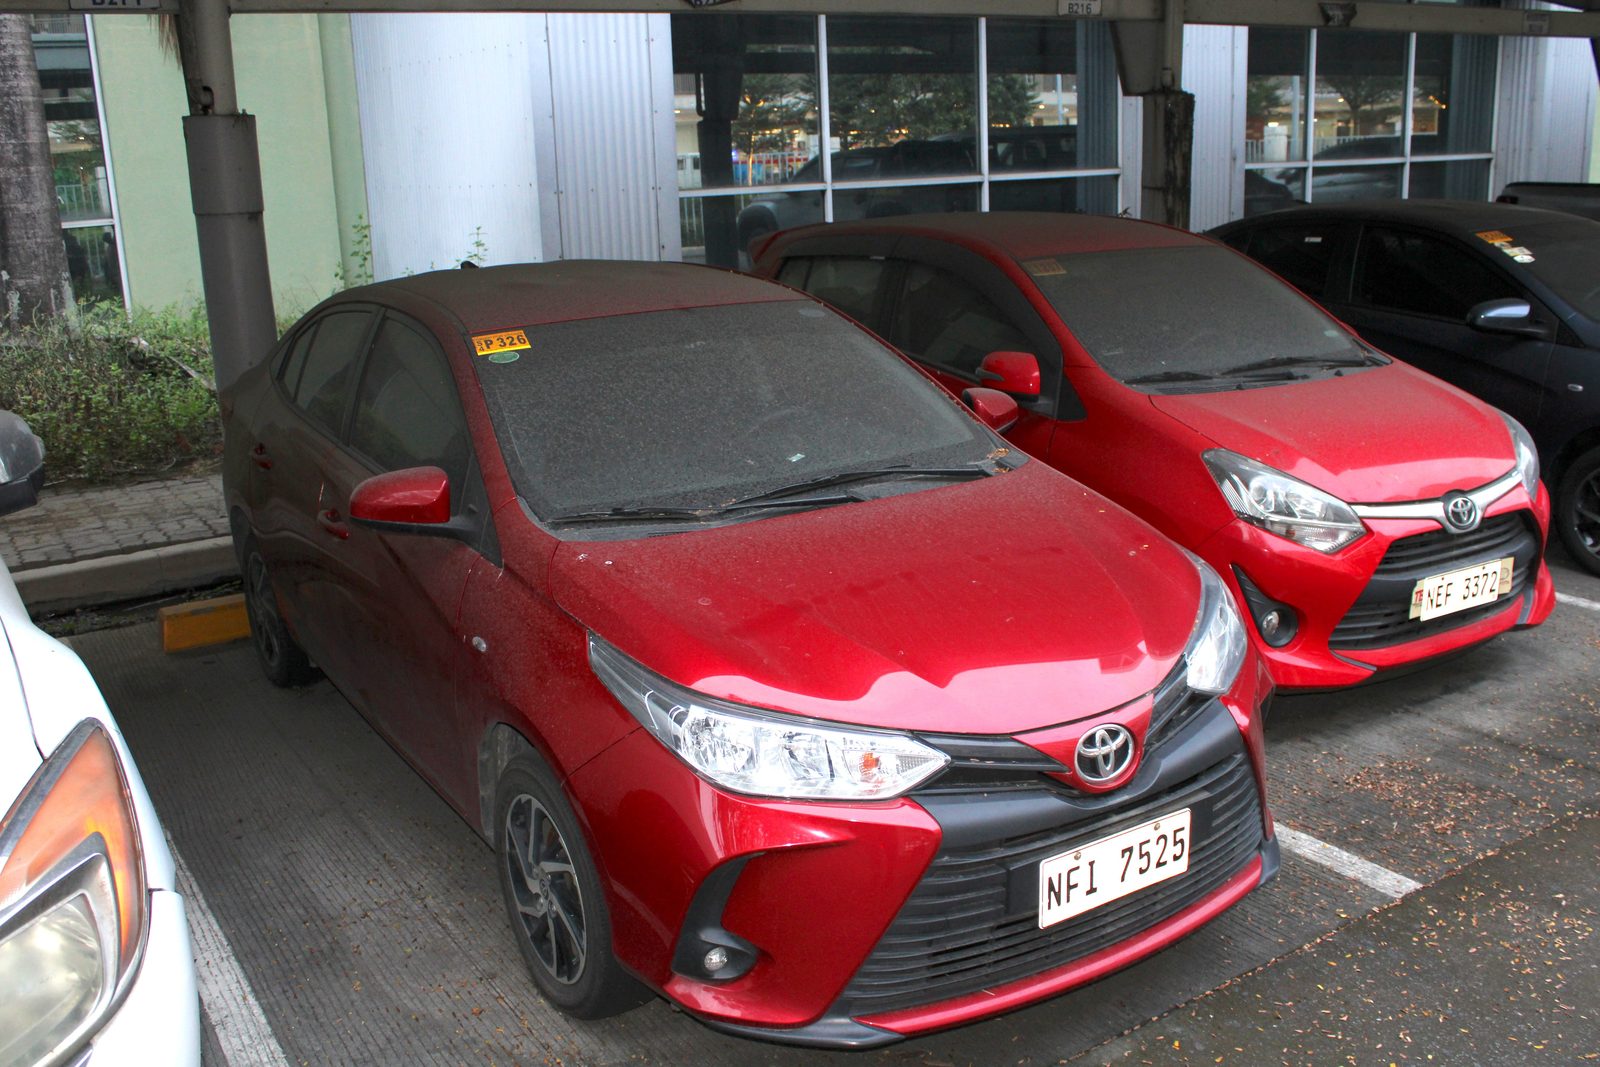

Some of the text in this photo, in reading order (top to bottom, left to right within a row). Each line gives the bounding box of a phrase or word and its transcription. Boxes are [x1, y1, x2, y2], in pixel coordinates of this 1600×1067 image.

[1068, 3, 1092, 14] B216
[496, 335, 526, 347] 326
[1426, 571, 1498, 610] NEF 3372
[1048, 827, 1186, 910] NFI 7525
